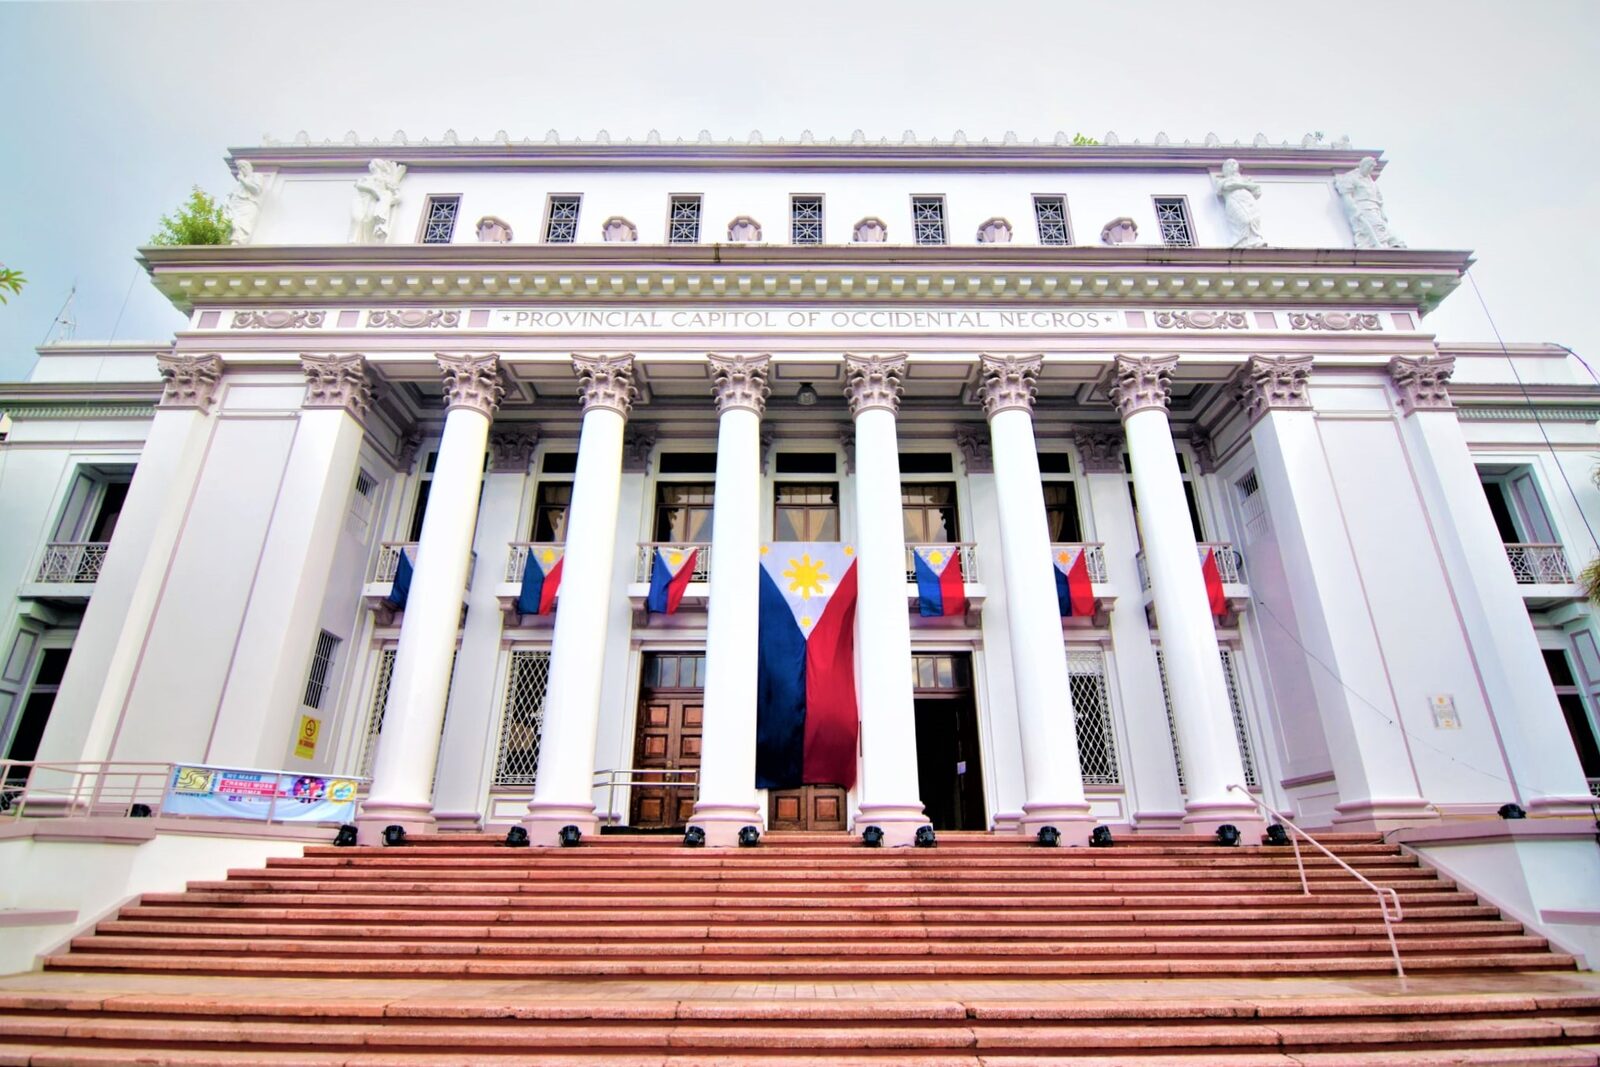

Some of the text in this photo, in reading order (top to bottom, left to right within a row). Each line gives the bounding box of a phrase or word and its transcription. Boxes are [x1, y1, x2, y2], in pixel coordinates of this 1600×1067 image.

[515, 311, 1100, 328] PROVINCIAL CAPITOL OF OCCIDENTAL NEGROS
[224, 780, 273, 790] CHANGE WORK
